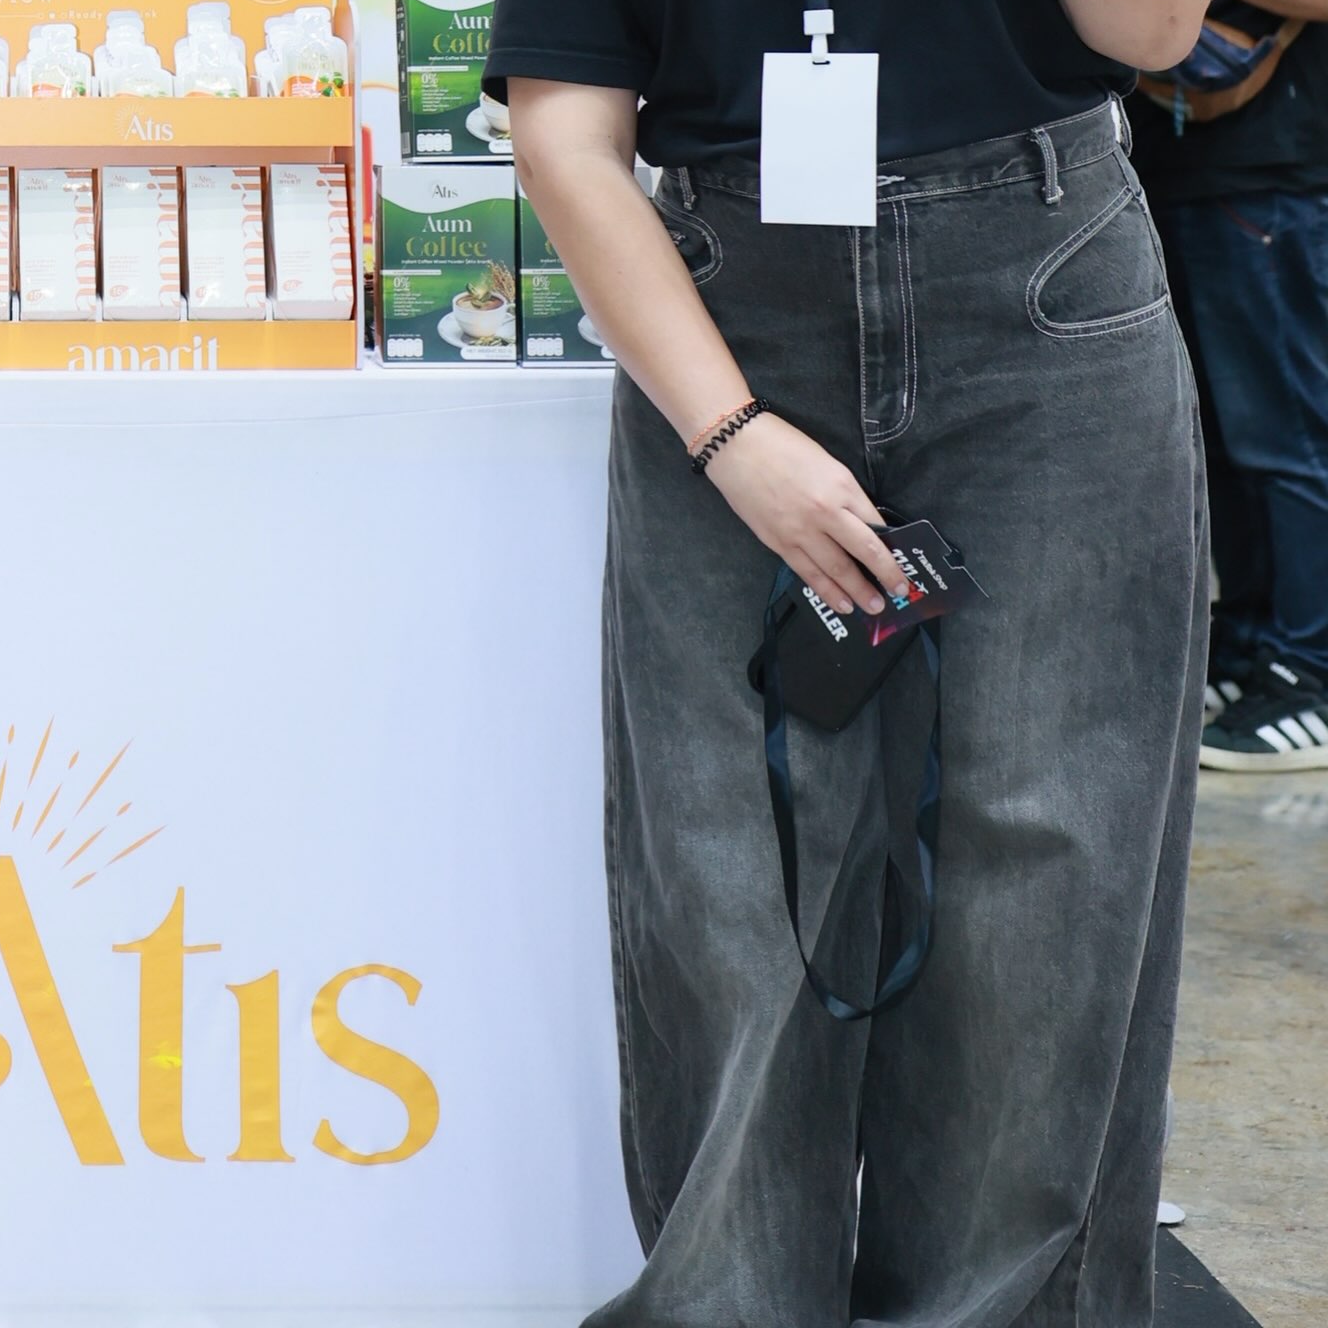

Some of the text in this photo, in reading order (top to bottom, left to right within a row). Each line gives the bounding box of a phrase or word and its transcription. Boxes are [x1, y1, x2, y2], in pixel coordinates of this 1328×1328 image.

[124, 114, 174, 142] Atis
[422, 215, 473, 233] Aum
[405, 235, 488, 258] Coffee
